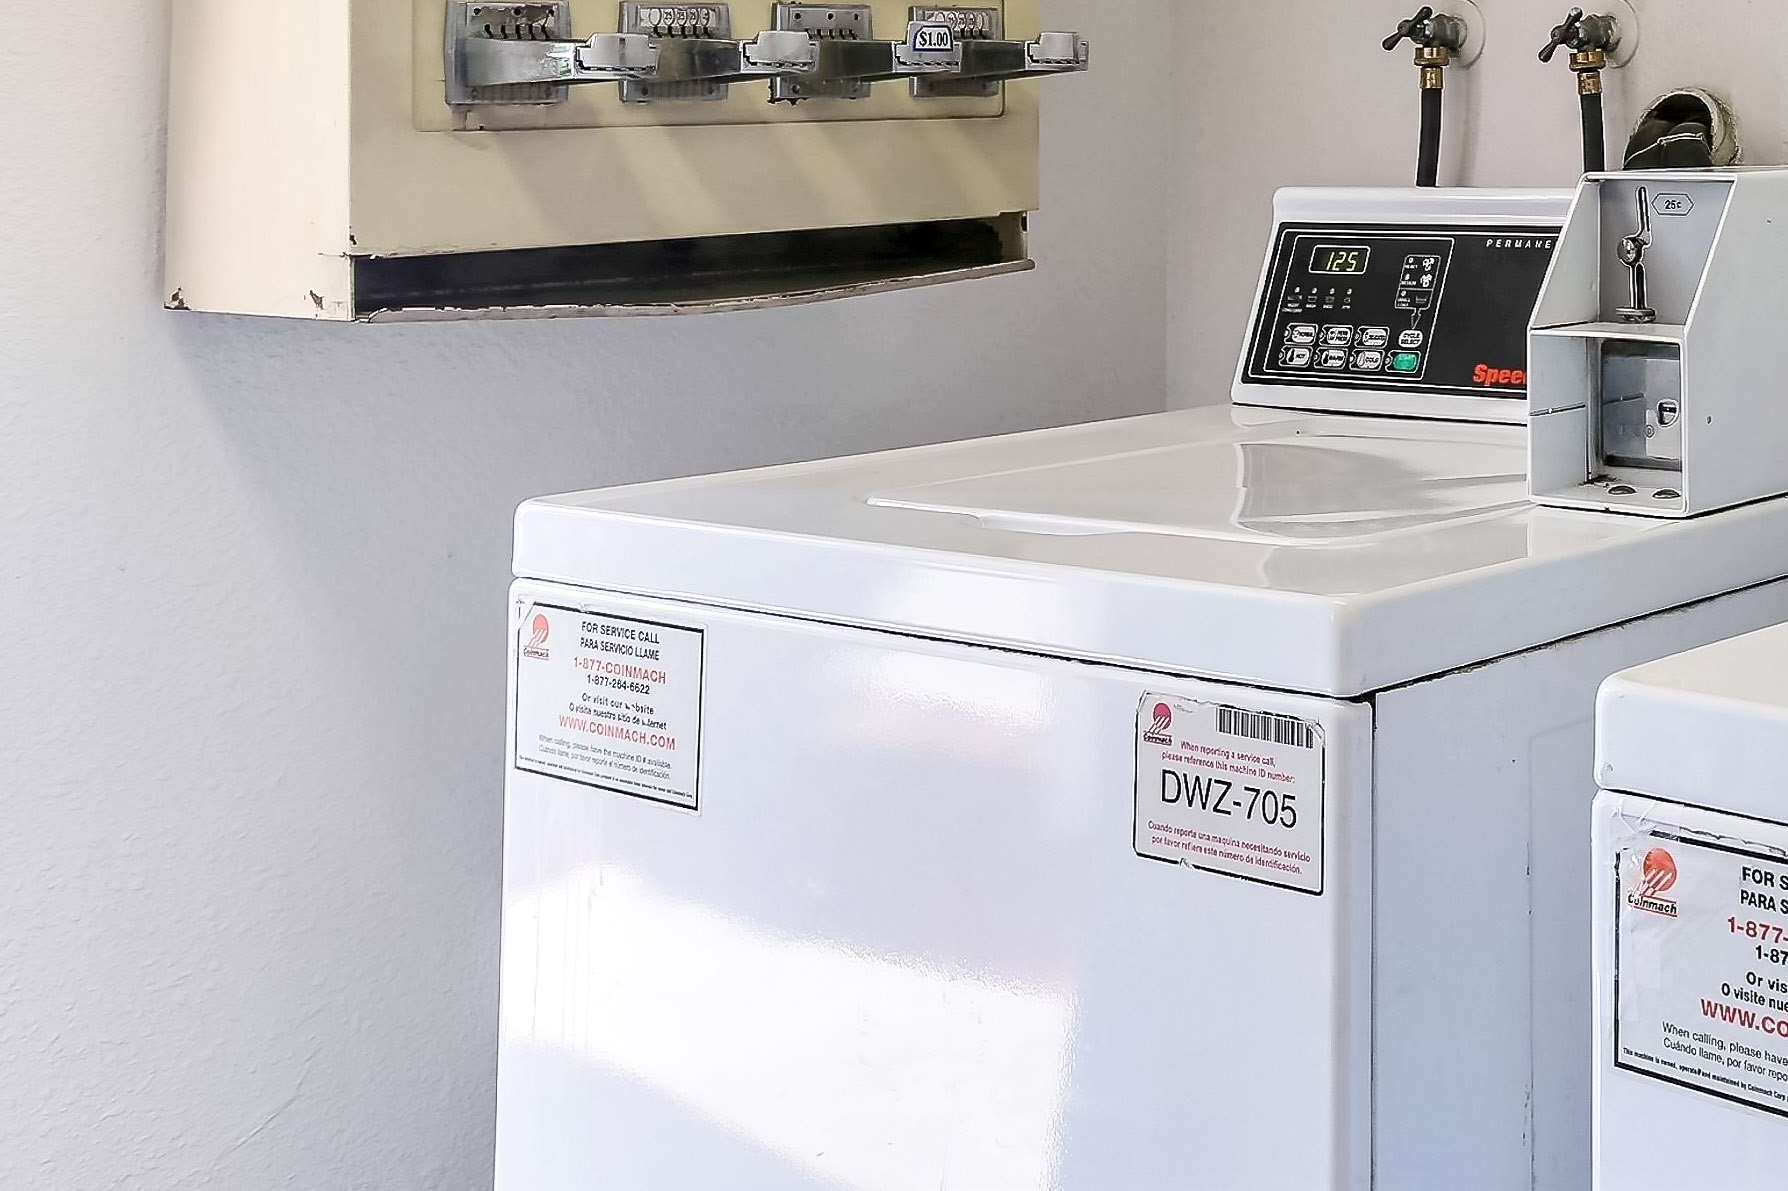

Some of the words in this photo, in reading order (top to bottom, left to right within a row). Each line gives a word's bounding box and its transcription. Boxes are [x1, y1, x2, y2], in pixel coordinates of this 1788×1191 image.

[919, 31, 948, 47] $1.00
[1486, 239, 1552, 248] PERMANE
[1326, 252, 1359, 271] 125
[1473, 364, 1526, 386] Spee
[581, 621, 598, 633] FOR
[600, 624, 635, 640] SERVICE
[638, 630, 659, 644] CALL
[580, 636, 598, 650] PARA
[600, 640, 633, 655] SERVICIO
[634, 646, 659, 661] LLAME
[574, 656, 665, 684] 1-877-COINMACH
[559, 715, 675, 750] WWW.COINMACH.COM
[1161, 768, 1296, 828] DWZ-705
[1742, 866, 1774, 887] FOR
[1740, 888, 1776, 912] PARA
[1745, 971, 1763, 987] Or
[1721, 982, 1730, 996] O
[1733, 986, 1765, 1005] visite
[1662, 1021, 1689, 1038] When
[1692, 1032, 1726, 1051] calling,
[1729, 1041, 1761, 1059] please
[1764, 1050, 1788, 1066] have
